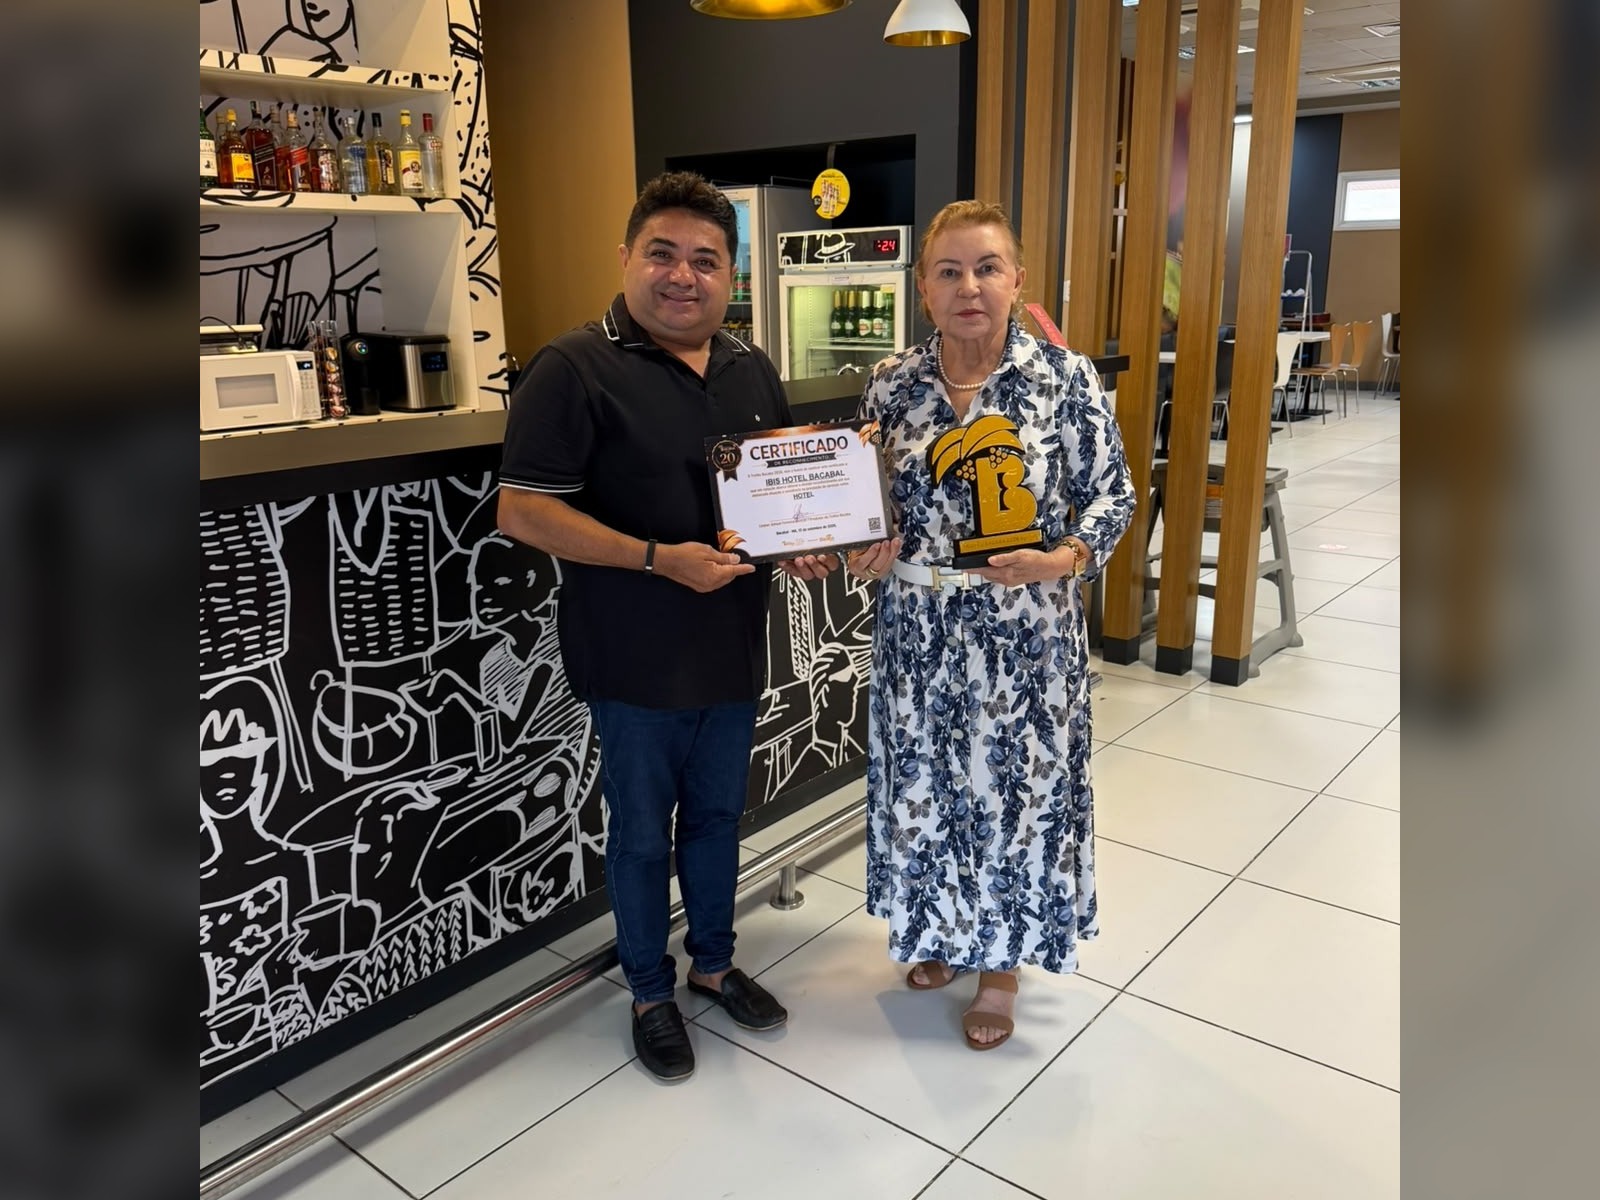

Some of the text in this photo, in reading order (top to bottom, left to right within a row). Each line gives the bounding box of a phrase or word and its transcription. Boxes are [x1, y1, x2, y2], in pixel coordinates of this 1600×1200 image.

[750, 435, 848, 460] CERTIFICADO
[719, 452, 736, 464] 20
[765, 478, 781, 486] IBIS
[781, 474, 807, 484] HOTEL
[808, 469, 845, 481] BACABAL
[793, 491, 815, 500] HOTEL
